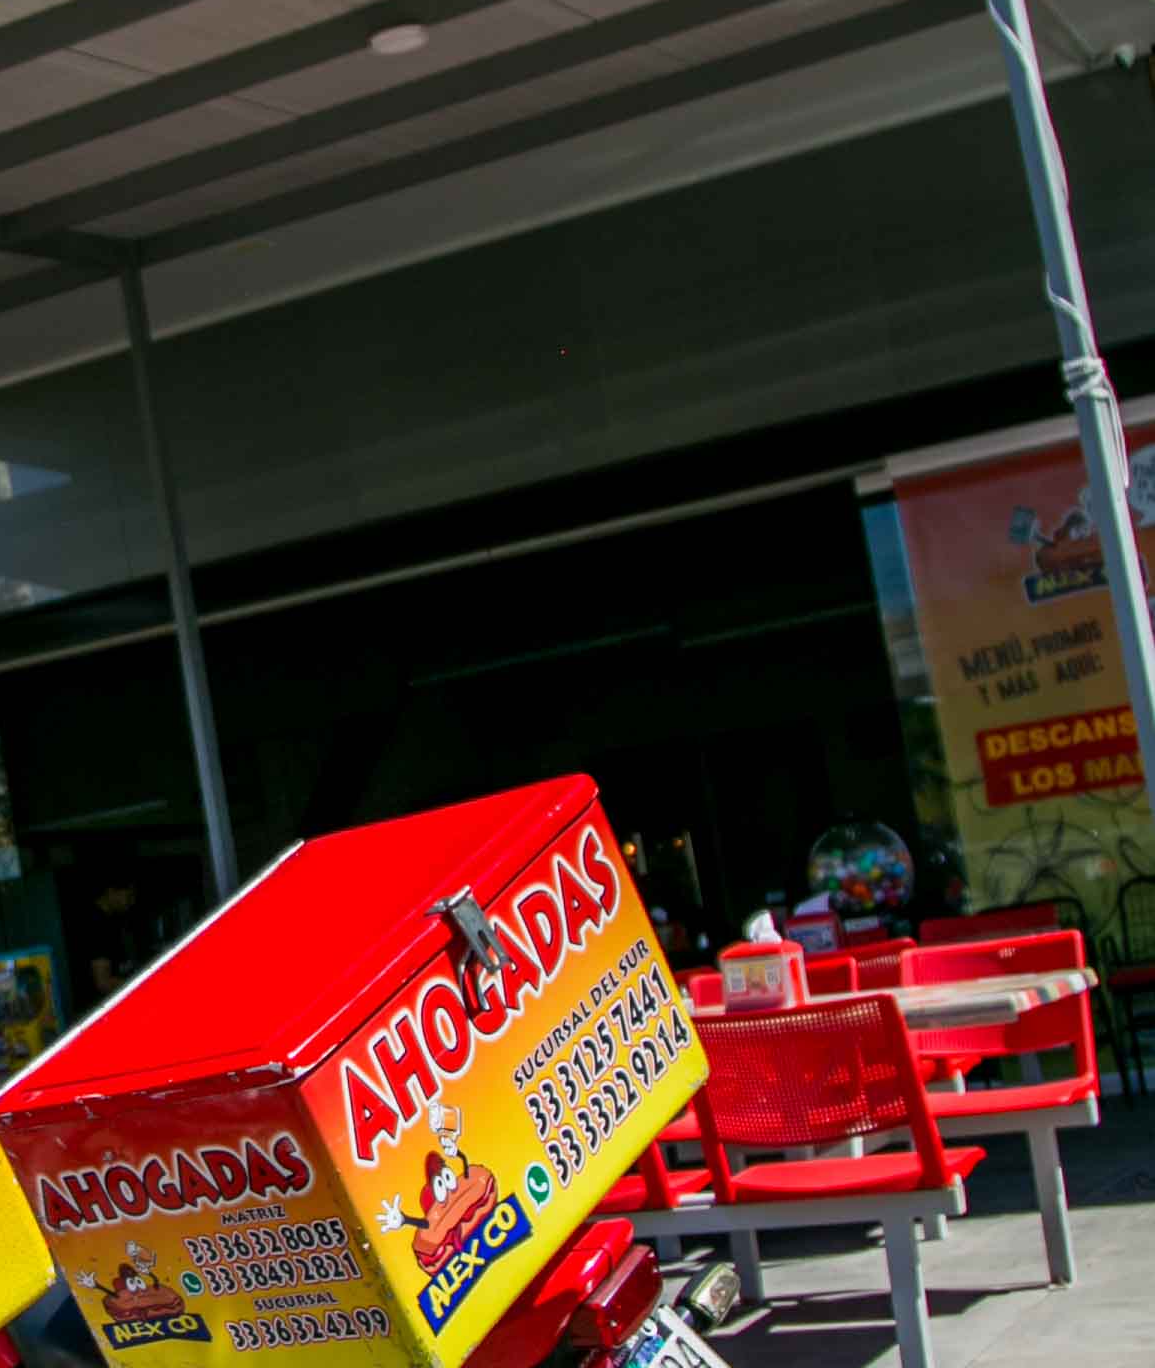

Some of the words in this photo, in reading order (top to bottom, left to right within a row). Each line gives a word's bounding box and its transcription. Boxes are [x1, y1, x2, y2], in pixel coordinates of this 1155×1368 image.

[985, 711, 1137, 762] DESCANS
[1011, 762, 1076, 797] LOS
[1083, 753, 1145, 783] MA
[514, 1002, 592, 1089] SUCURSAL
[590, 972, 620, 1008] DEL
[619, 939, 650, 977] SUR
[528, 1081, 562, 1137] 33
[558, 1020, 614, 1104] 3125
[611, 965, 670, 1042] 7441
[548, 1128, 582, 1183] 33
[578, 1070, 638, 1150] 3322
[631, 1008, 688, 1086] 9214
[40, 1136, 310, 1229] AHOGADAS
[221, 1206, 286, 1225] MATRIZ
[429, 1239, 486, 1319] ALEX
[484, 1203, 517, 1248] CO
[113, 1321, 166, 1343] ALEX
[168, 1315, 199, 1333] CO
[253, 1293, 337, 1311] SUCURSAL
